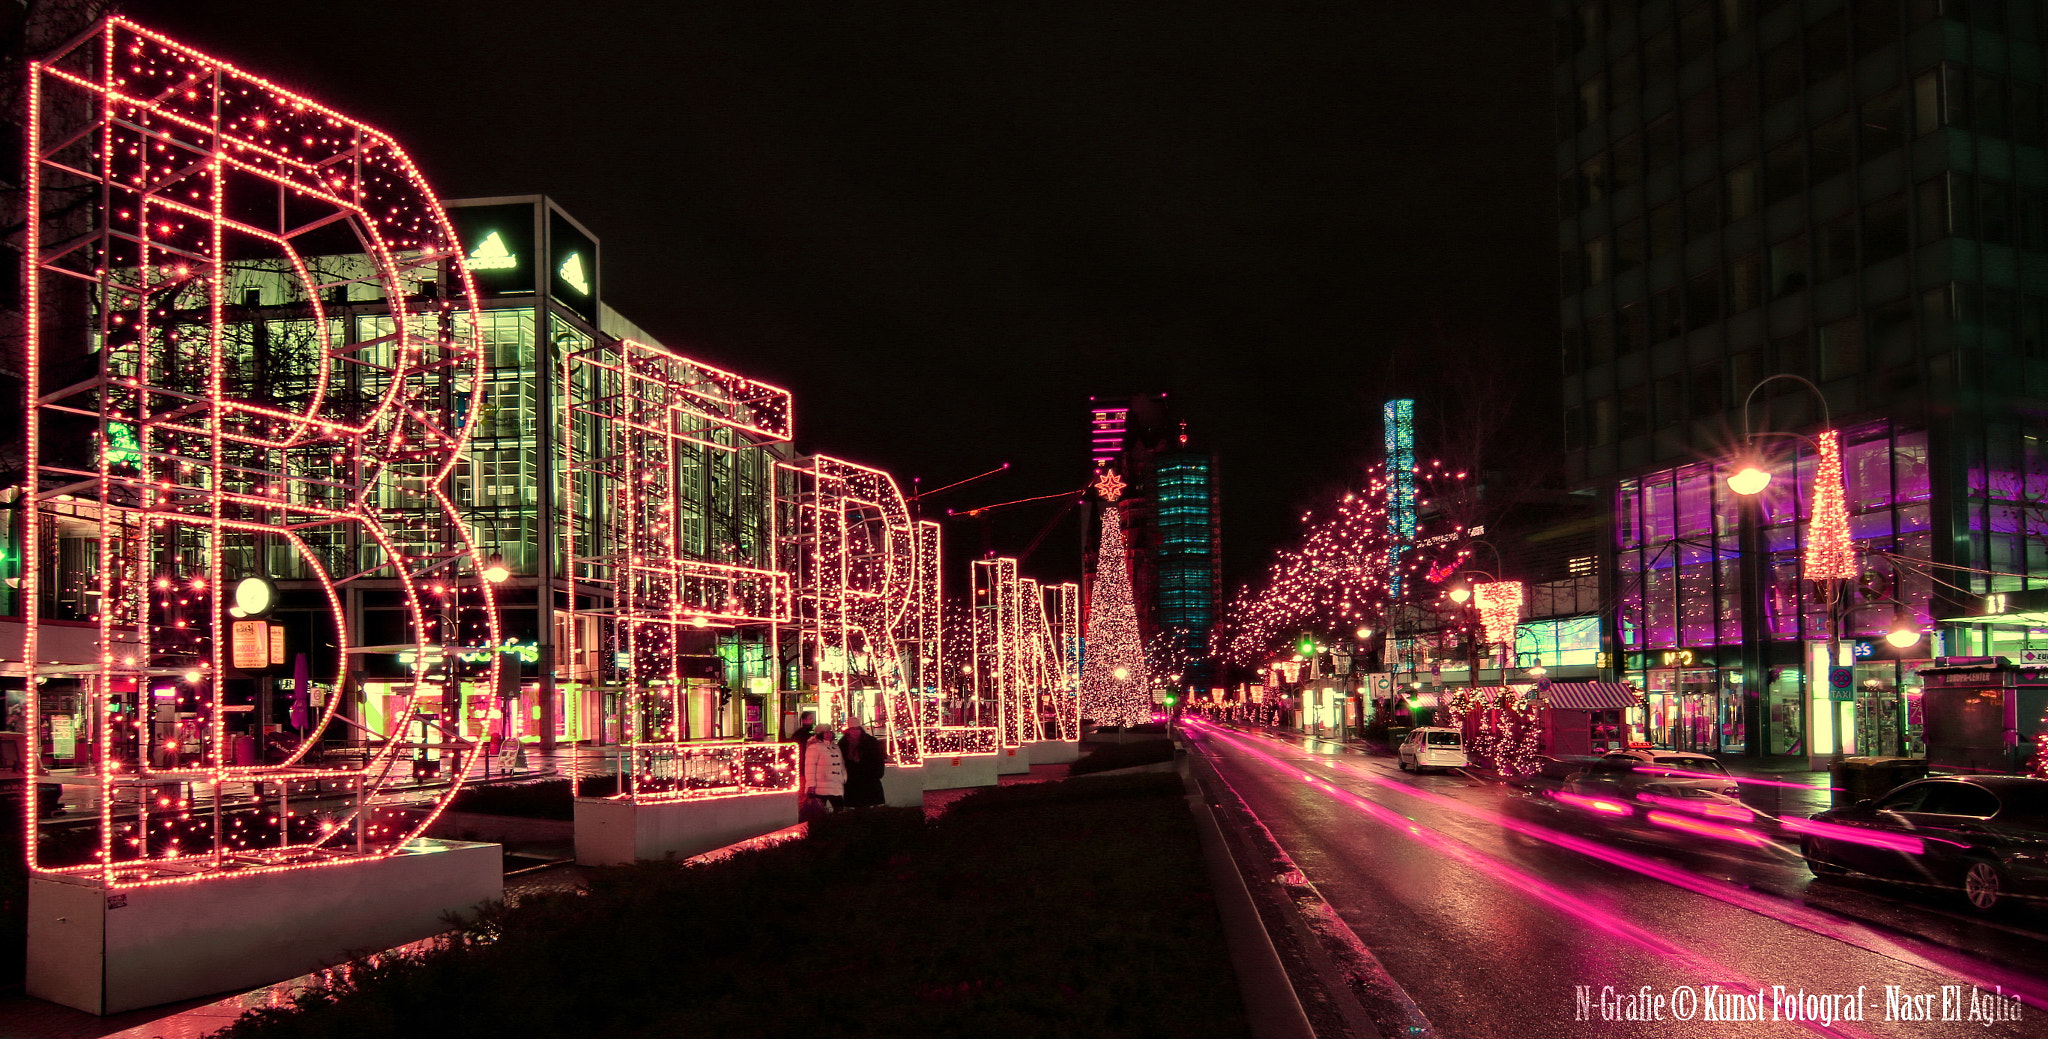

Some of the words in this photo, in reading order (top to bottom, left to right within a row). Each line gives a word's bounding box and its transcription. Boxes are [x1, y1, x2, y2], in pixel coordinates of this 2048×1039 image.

[27, 15, 1083, 891] BERLIN
[1664, 650, 1693, 666] NO
[1831, 690, 1851, 699] TAXI
